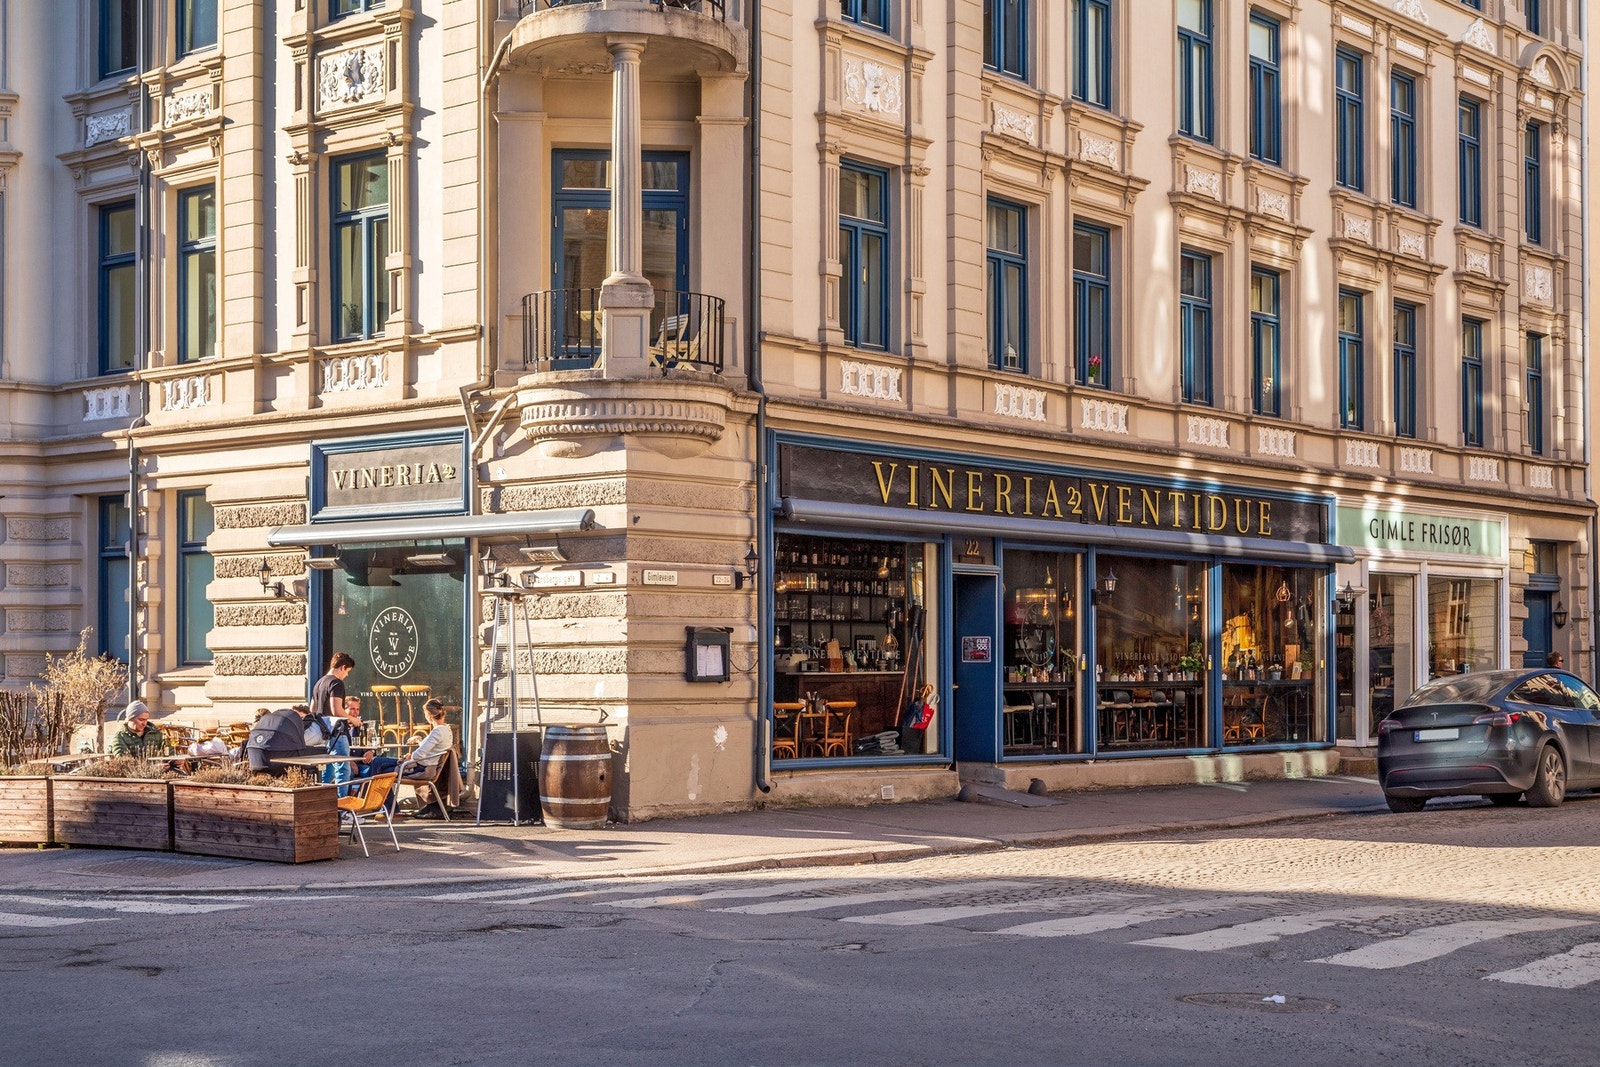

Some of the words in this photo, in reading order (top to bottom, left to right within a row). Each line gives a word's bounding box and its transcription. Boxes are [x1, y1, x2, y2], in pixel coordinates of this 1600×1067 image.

[331, 461, 443, 490] VINERIA
[871, 461, 1064, 518] VINERIA
[1087, 483, 1273, 536] VENTIDUE
[1369, 518, 1415, 542] GIMLE
[1421, 523, 1472, 547] FRISØR
[965, 539, 980, 556] 22
[373, 612, 413, 634] VINERIA
[373, 645, 416, 674] VENTIDUE
